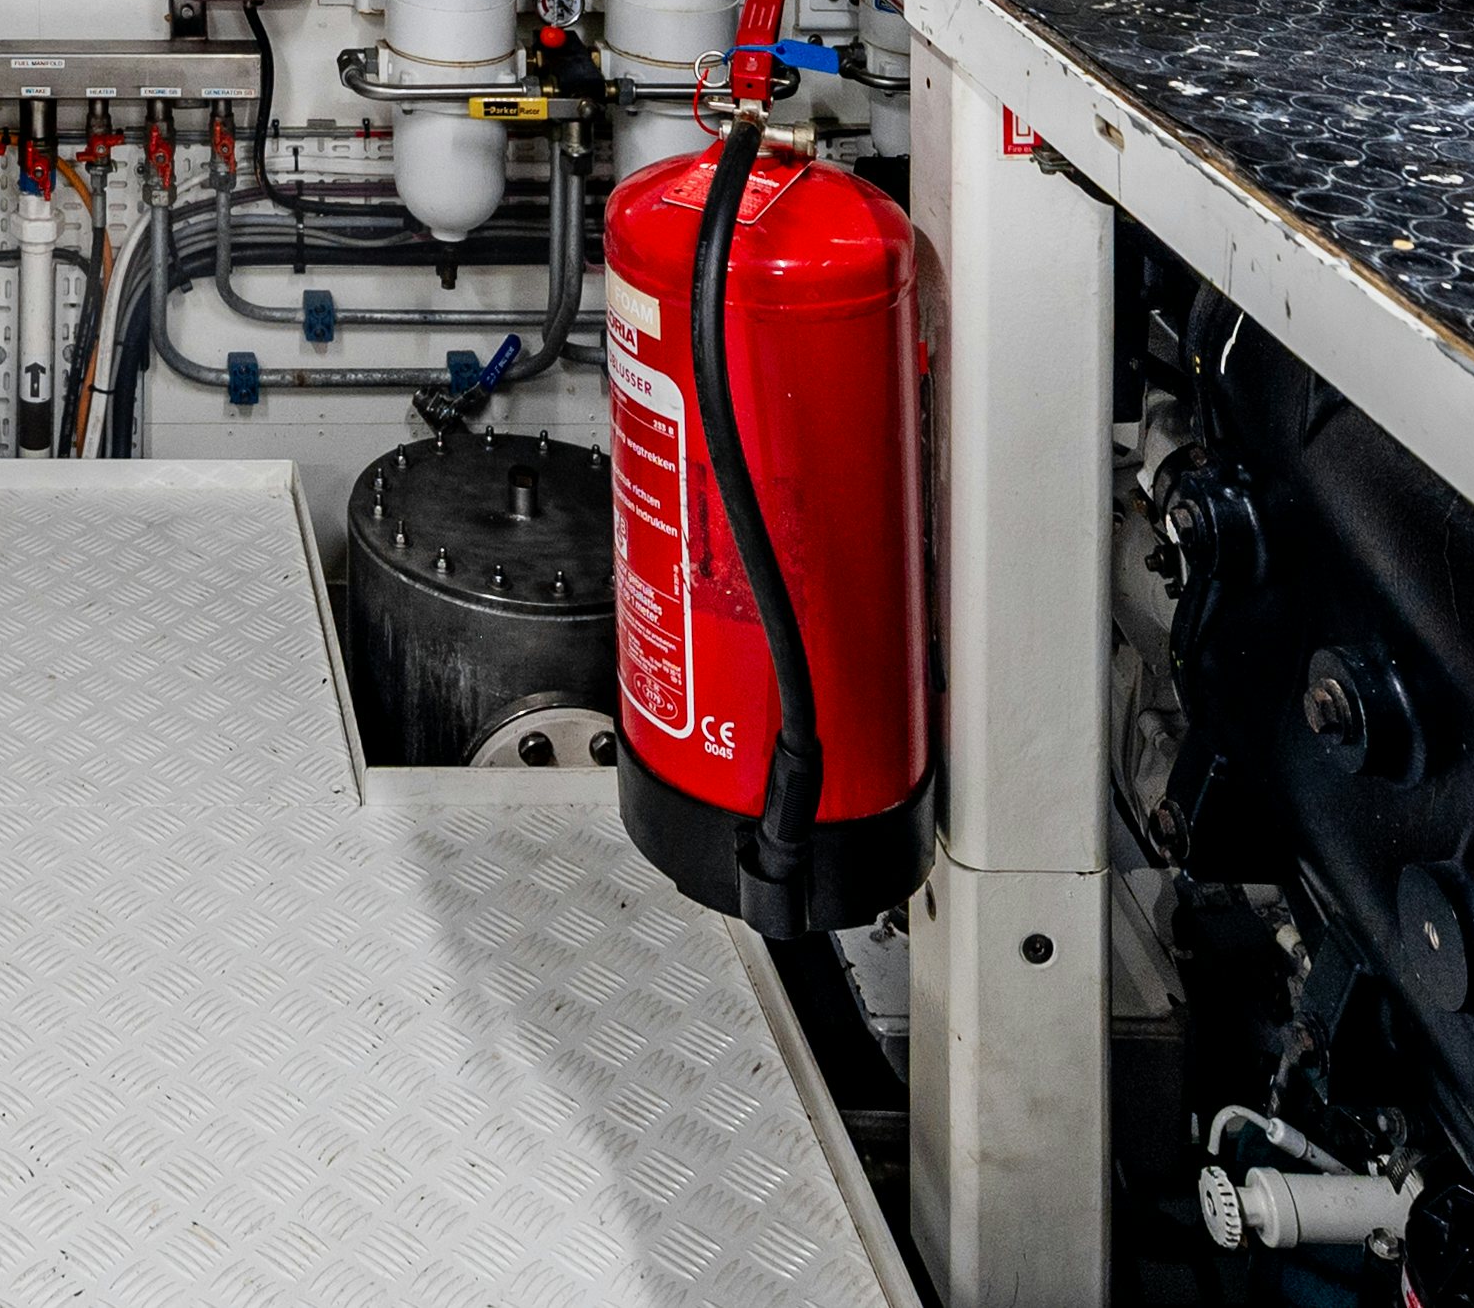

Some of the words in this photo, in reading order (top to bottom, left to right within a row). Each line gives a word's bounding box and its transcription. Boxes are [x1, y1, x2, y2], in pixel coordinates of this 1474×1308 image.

[488, 104, 518, 115] Parker
[613, 285, 654, 325] FOAM
[704, 740, 734, 760] 0045
